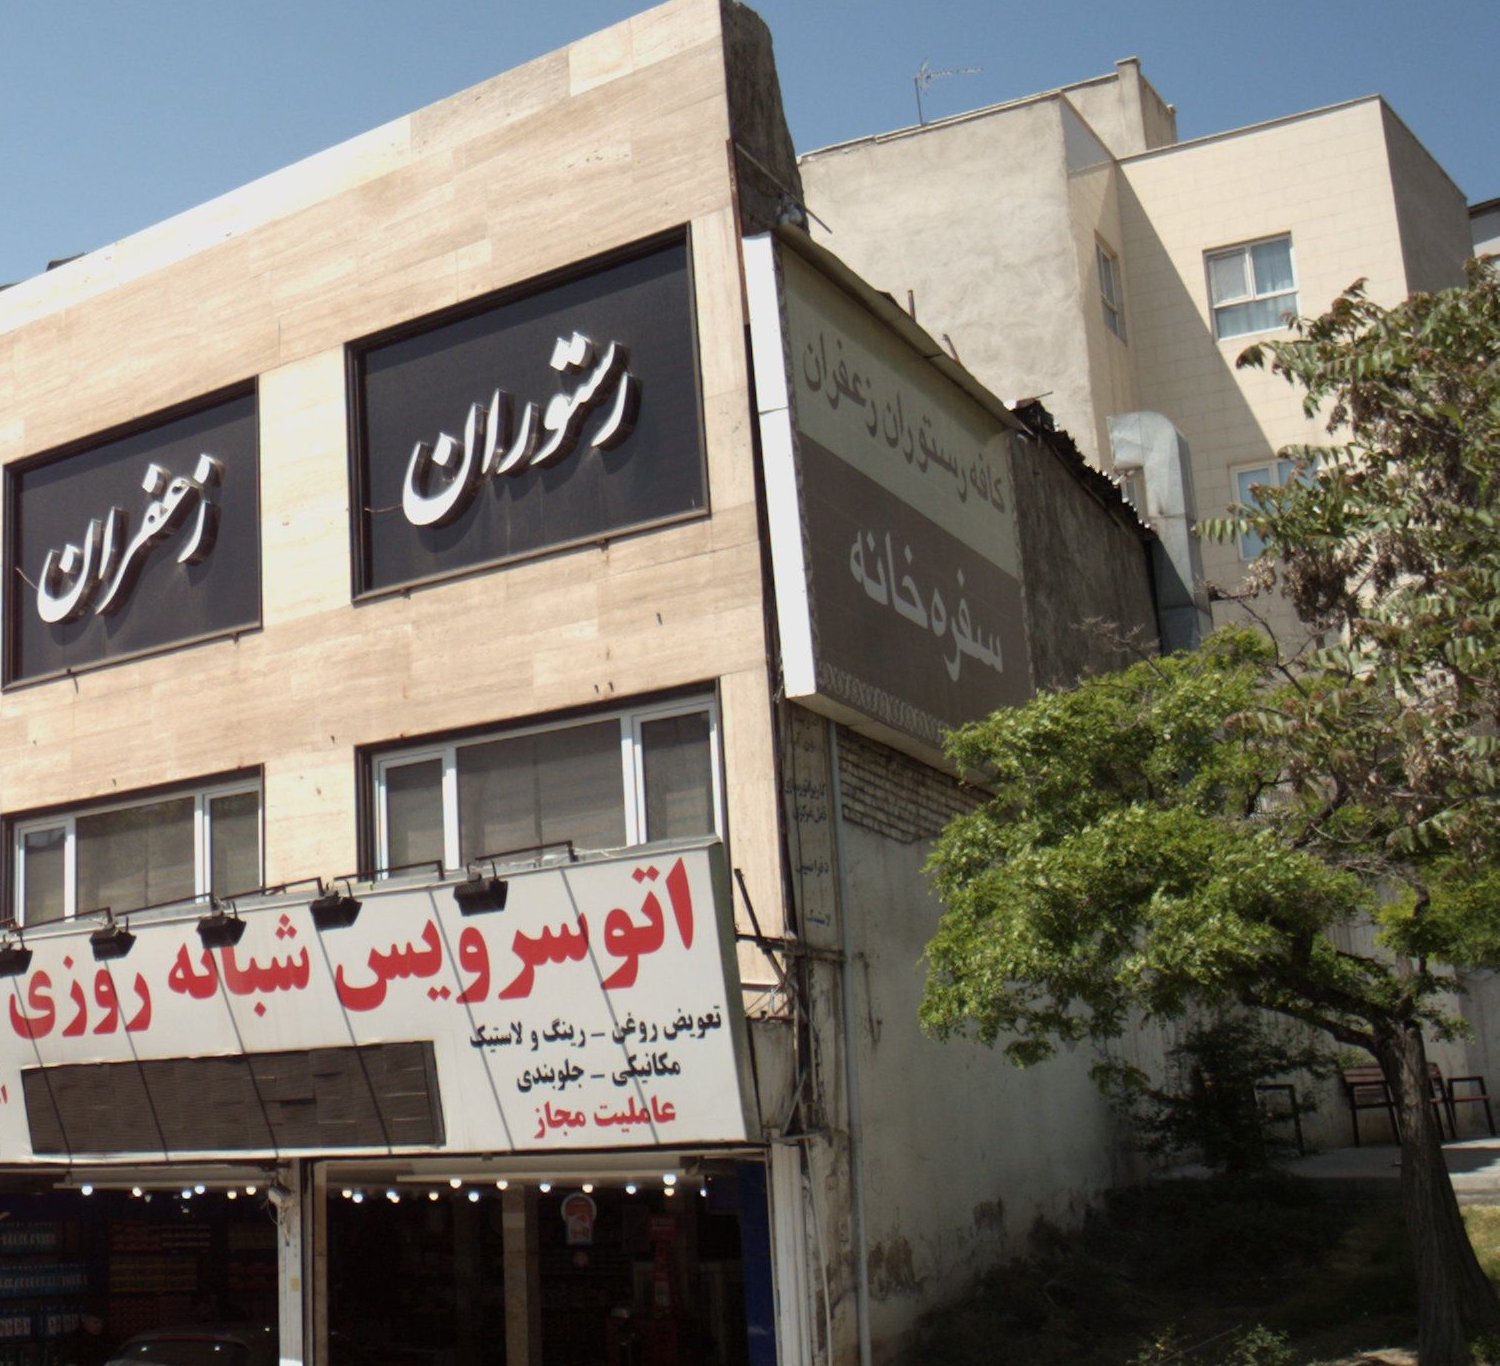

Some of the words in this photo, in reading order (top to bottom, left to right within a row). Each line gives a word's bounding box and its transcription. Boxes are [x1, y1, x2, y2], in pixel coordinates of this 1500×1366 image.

[803, 332, 880, 438] زعفران
[403, 332, 642, 526] رستوران
[882, 391, 968, 504] رستوران
[37, 454, 224, 623] زعفران
[470, 1020, 523, 1053] لاستیک
[531, 1031, 539, 1051] و
[542, 1018, 586, 1048] رینگ
[612, 1012, 657, 1044] روغن
[663, 1005, 722, 1041] تعویض
[516, 1058, 584, 1092] جلوبندی
[612, 1052, 681, 1086] مکانیکی
[534, 1100, 586, 1139] مجاز
[593, 1094, 676, 1133] عاملیت
